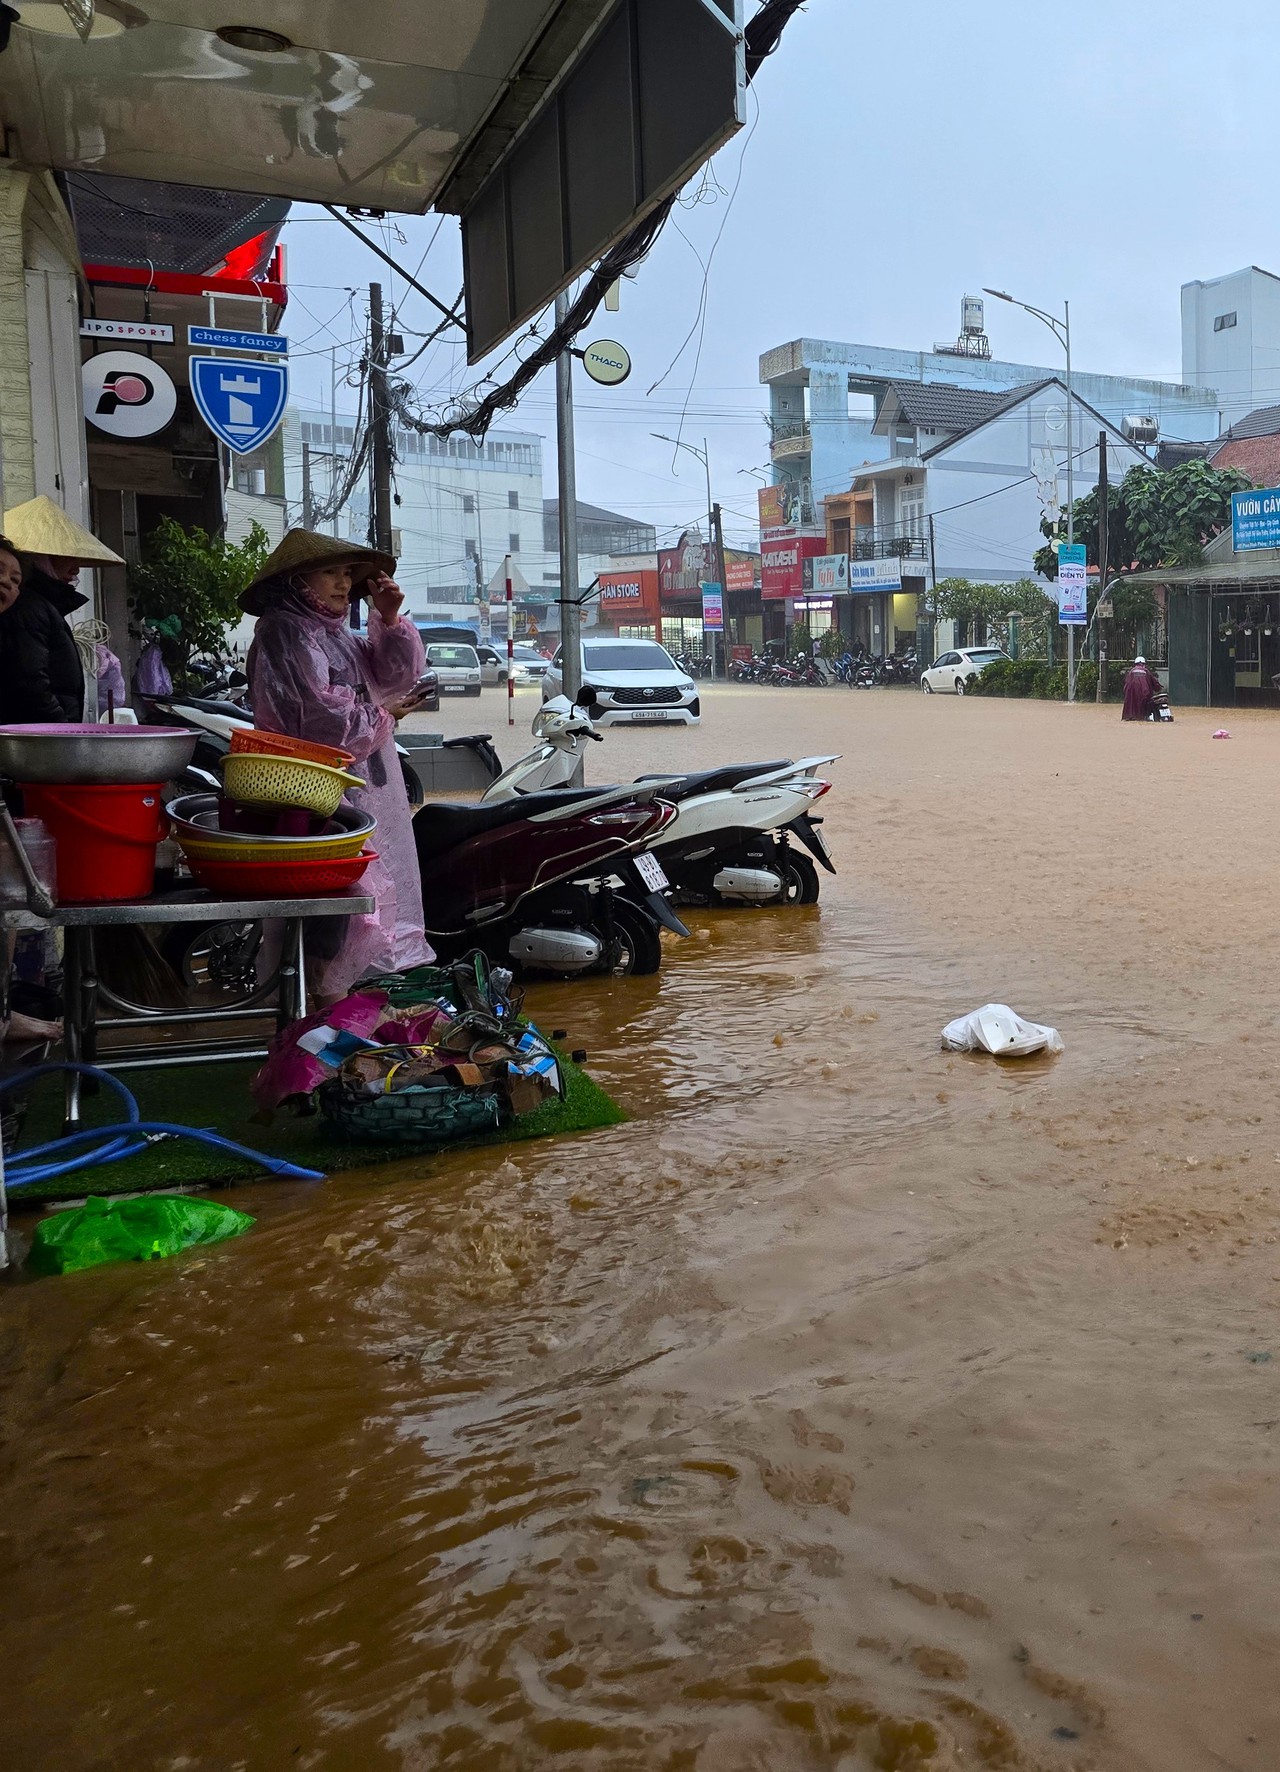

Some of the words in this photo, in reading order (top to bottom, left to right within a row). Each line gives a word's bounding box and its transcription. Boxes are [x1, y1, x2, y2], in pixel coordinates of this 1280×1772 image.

[195, 331, 237, 343] chess
[240, 336, 283, 349] fancy
[590, 353, 624, 370] THACO
[1236, 498, 1261, 517] VƯỜN
[601, 582, 616, 599] HÂN
[616, 582, 640, 598] STORE
